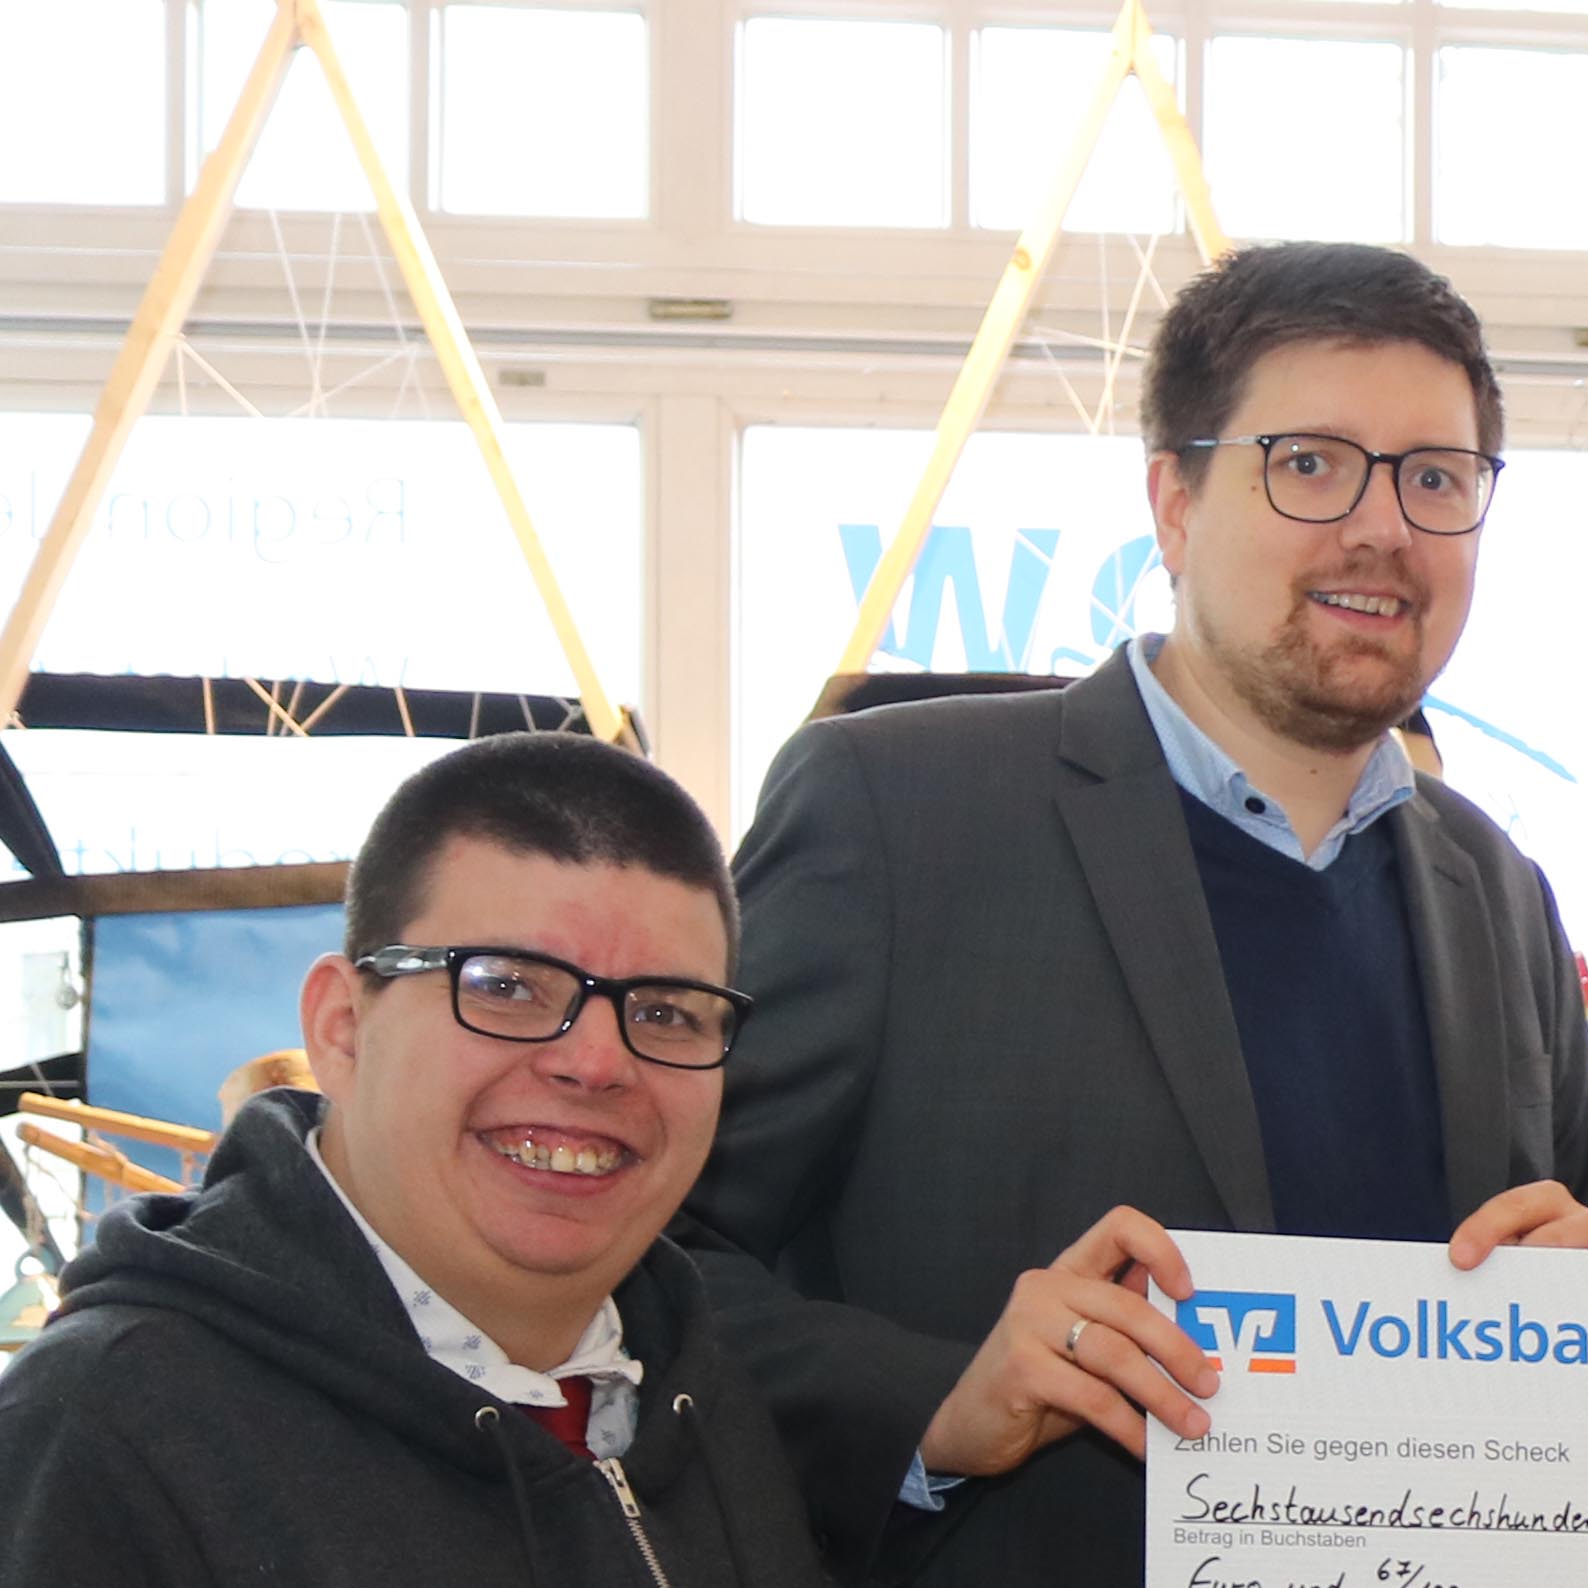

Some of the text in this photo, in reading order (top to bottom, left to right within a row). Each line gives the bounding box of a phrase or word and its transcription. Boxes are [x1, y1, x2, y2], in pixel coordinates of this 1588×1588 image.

[1174, 1432, 1570, 1463] Zahlen Sie gegen diesen Scheck
[1174, 1528, 1367, 1548] Betrag in Buchstaben
